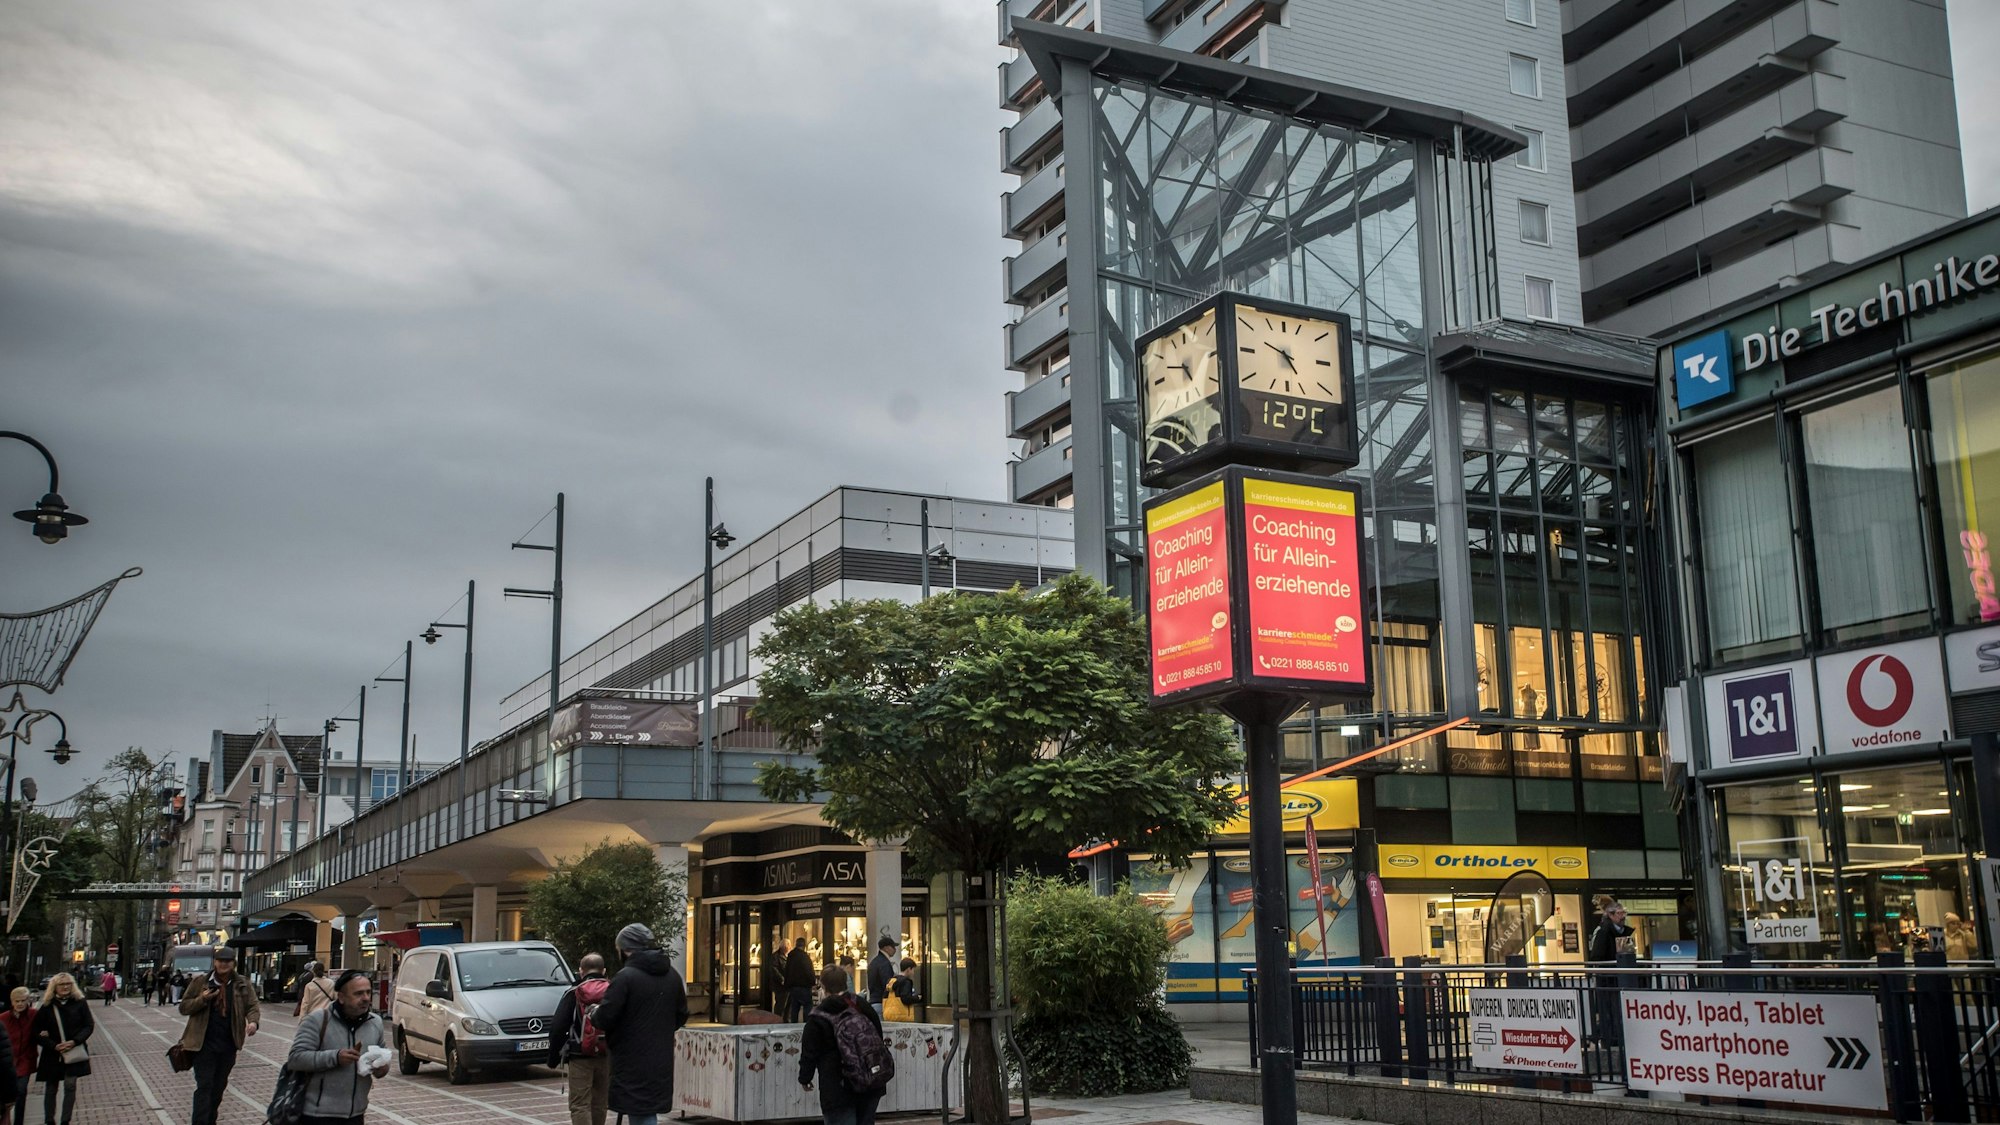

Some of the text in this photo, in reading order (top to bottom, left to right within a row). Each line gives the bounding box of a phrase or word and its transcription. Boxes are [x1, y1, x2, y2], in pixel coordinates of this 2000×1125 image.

[1742, 325, 1800, 371] Die
[1683, 353, 1721, 383] TK
[1251, 491, 1347, 510] karriereschmiede-koeln.de
[1253, 515, 1335, 546] Coaching
[1155, 525, 1212, 558] Coaching
[1254, 543, 1337, 568] für Allein-
[1155, 554, 1213, 585] für Allein-
[1157, 576, 1224, 612] erziehende
[1256, 573, 1351, 598] erziehende
[1258, 627, 1333, 641] karriereschmiede
[1158, 636, 1210, 656] karriereschmiede
[1271, 657, 1293, 668] 0221
[1166, 671, 1182, 684] 0221
[590, 713, 632, 721] Abendkleider
[1732, 692, 1788, 737] 1&1
[589, 722, 627, 730] Accessoires
[615, 733, 634, 741] Etage
[1852, 729, 1921, 748] vodafone
[1590, 762, 1626, 772] Brautkleider
[1648, 765, 1662, 773] Aben
[823, 862, 866, 880] ASA
[1435, 855, 1538, 868] OrthoLev
[1747, 858, 1805, 902] 1&1
[1754, 923, 1808, 939] Partner
[1471, 998, 1576, 1021] KOPIEREN, DRUCKEN, SCANNEN
[1626, 999, 1825, 1027] Handy, Ipad, Tablet
[1505, 1032, 1568, 1046] Wiesdorfer Platz 66
[1660, 1029, 1789, 1059] Smartphone
[1517, 1057, 1546, 1068] Phone
[1547, 1059, 1578, 1069] Center
[1629, 1058, 1826, 1092] Express Reparatur
